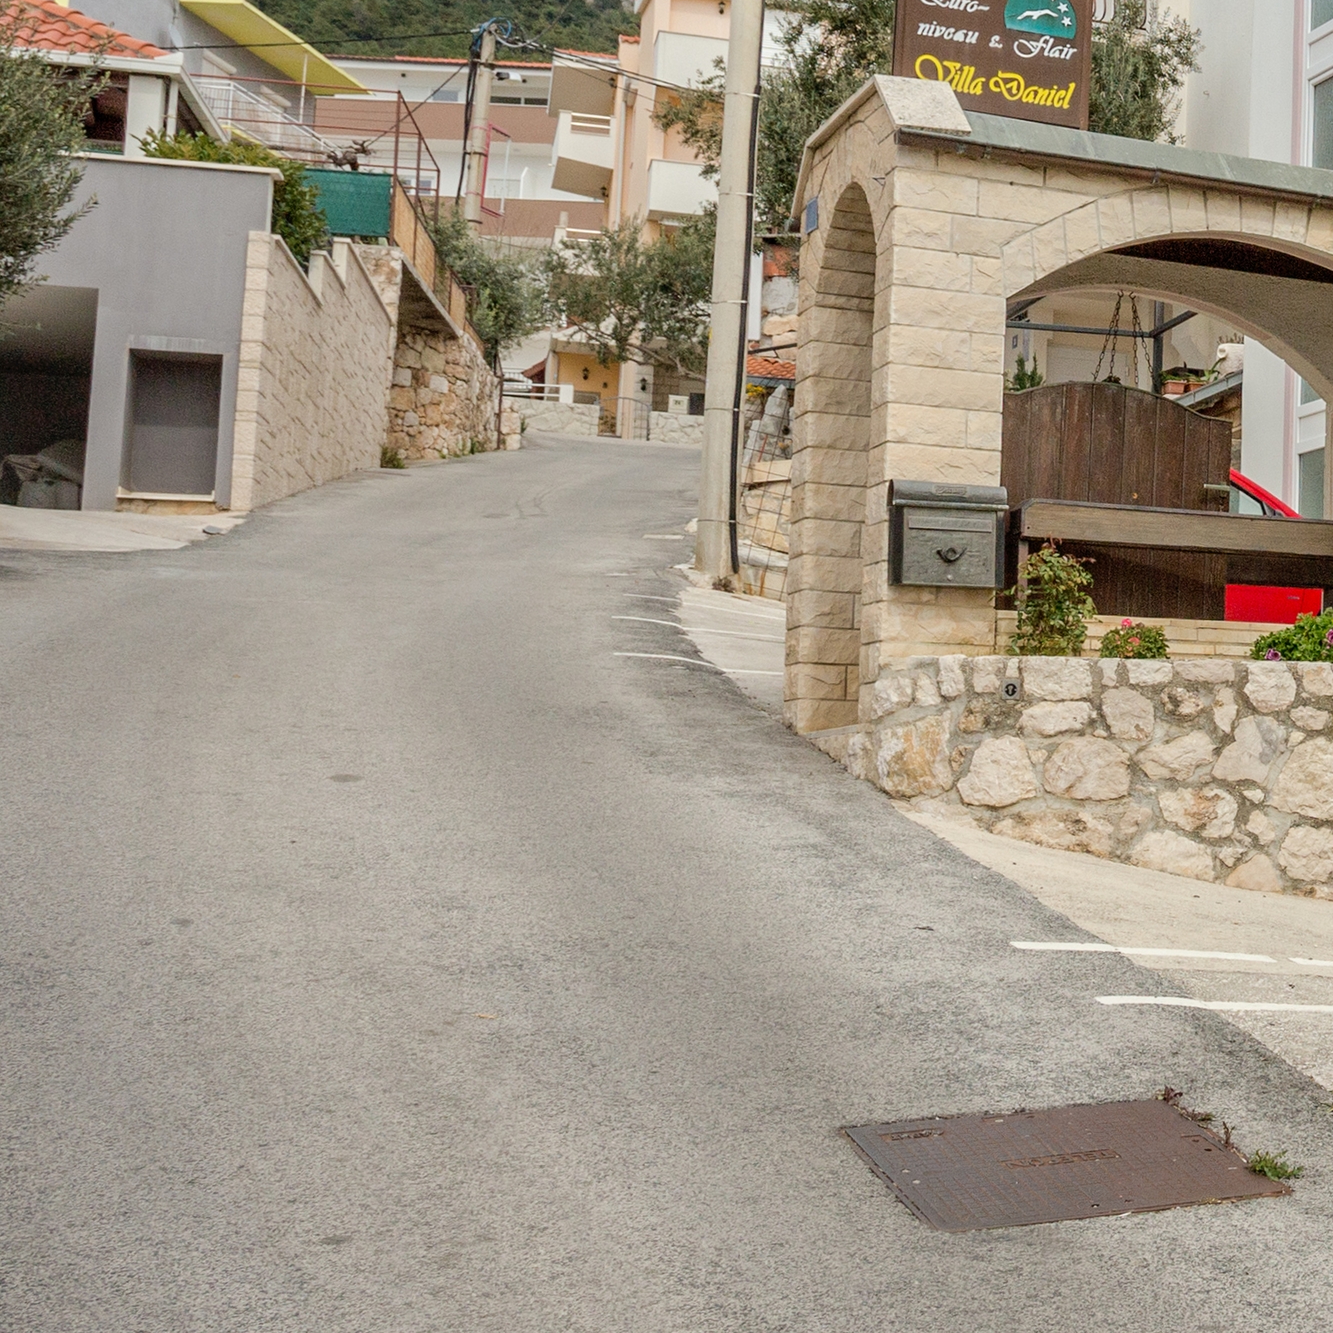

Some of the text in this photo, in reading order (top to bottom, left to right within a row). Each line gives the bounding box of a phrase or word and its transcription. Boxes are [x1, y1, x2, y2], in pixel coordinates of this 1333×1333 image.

[918, 21, 1077, 60] niveau & Flair
[914, 54, 1076, 109] Villa Daniel
